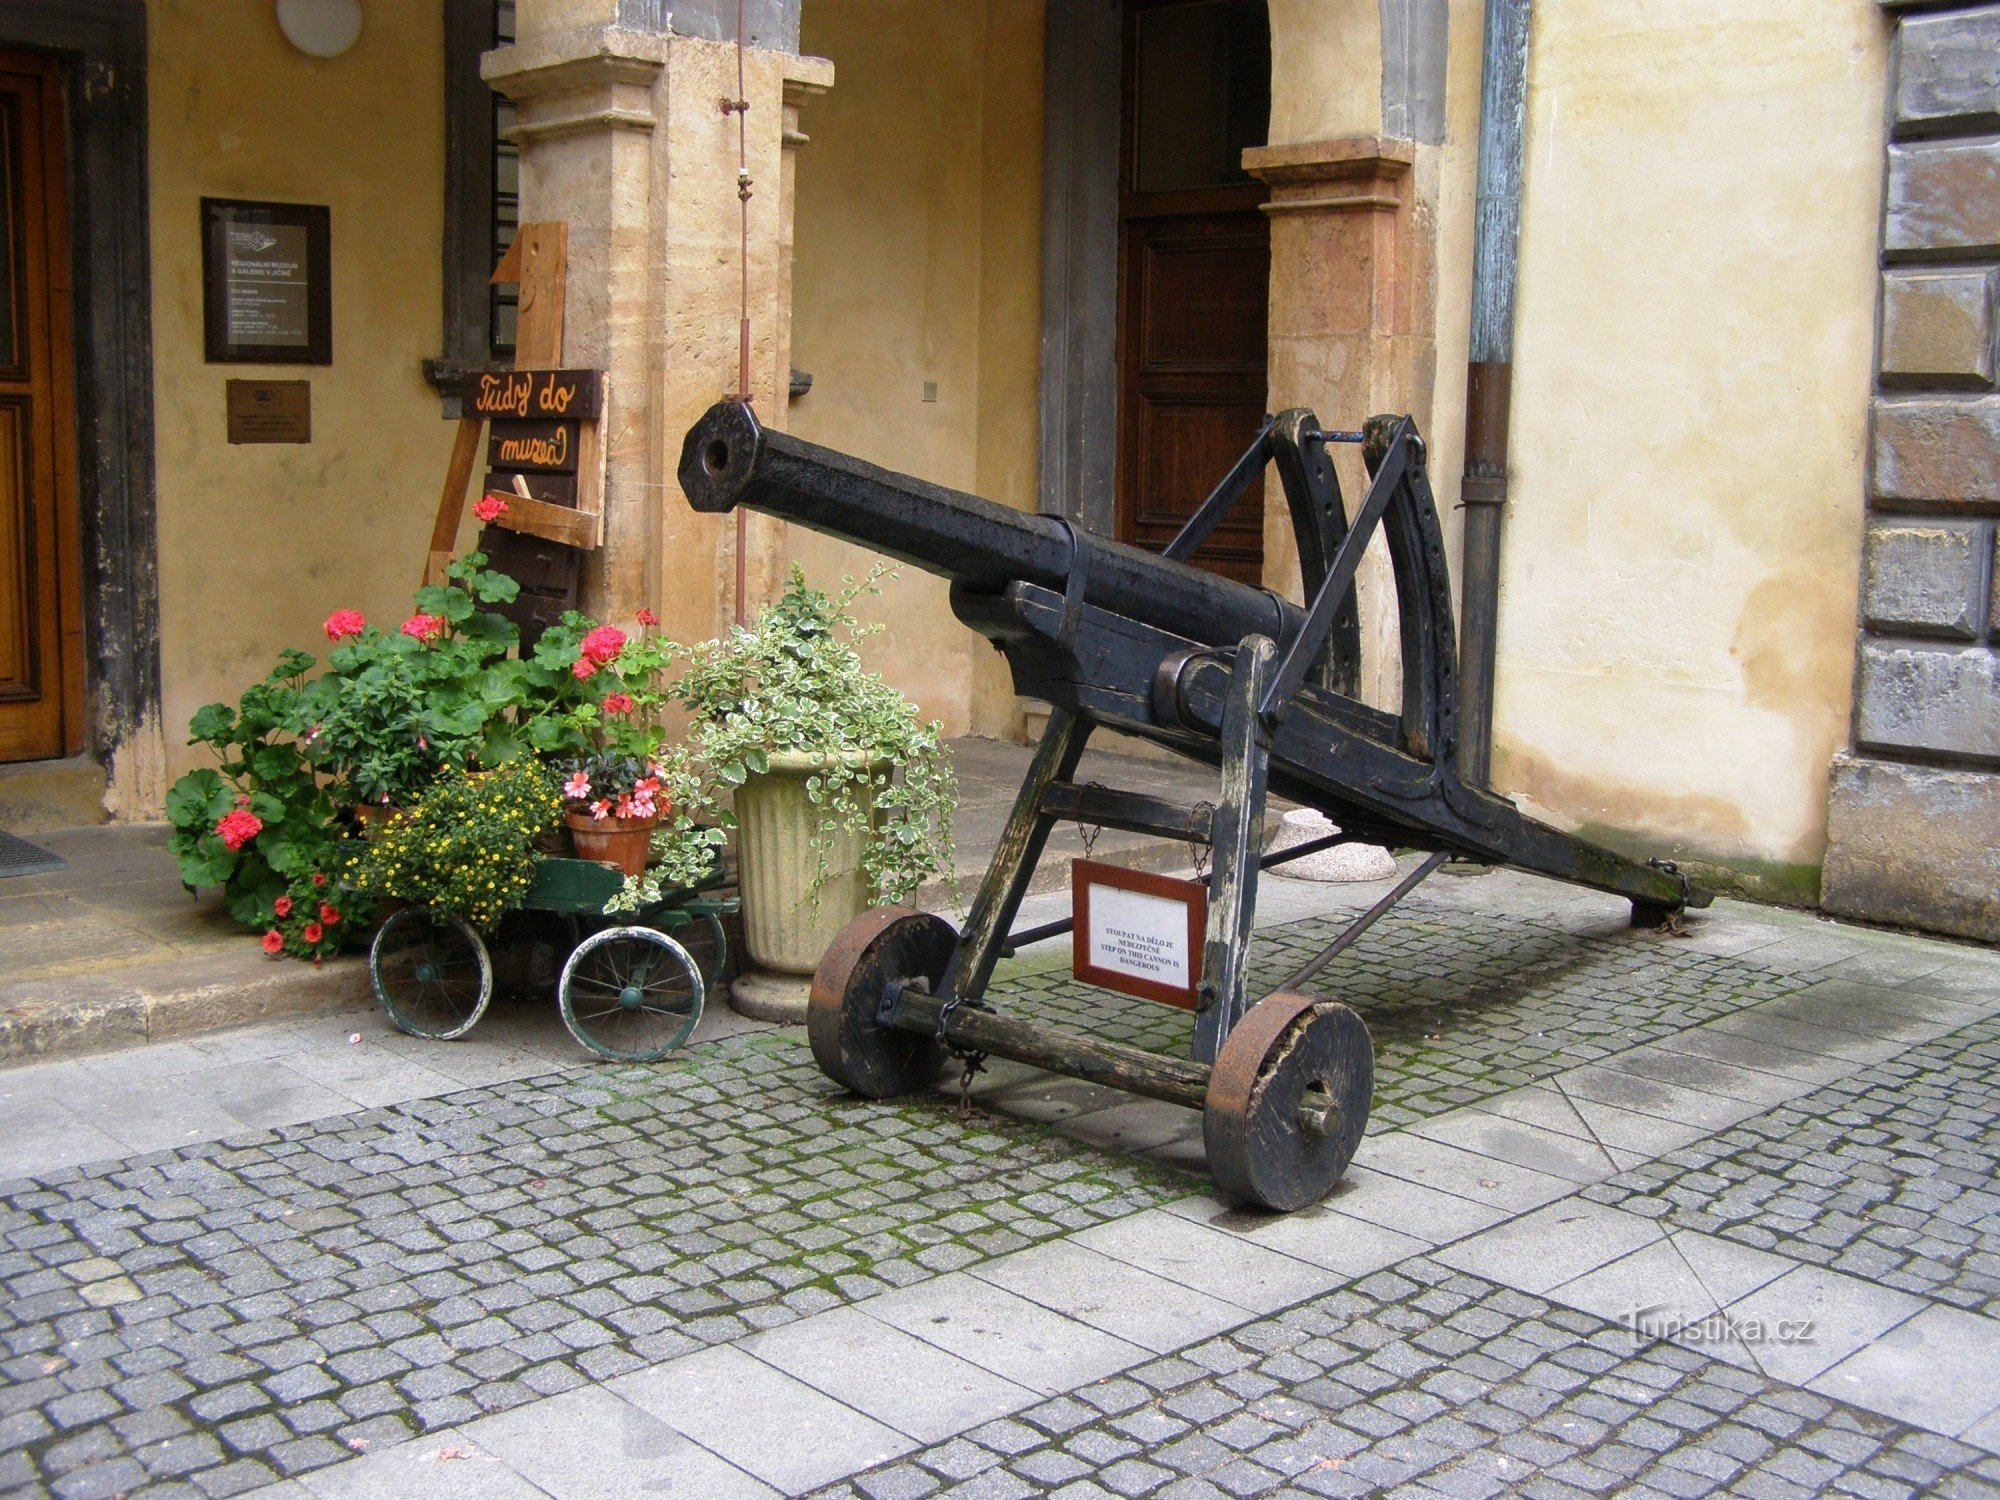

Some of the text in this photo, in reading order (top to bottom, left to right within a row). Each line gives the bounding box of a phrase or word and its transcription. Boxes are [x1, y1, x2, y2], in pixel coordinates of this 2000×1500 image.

[271, 261, 298, 269] MUZEUM
[476, 373, 576, 417] Tudy do
[501, 426, 567, 466] muzea
[1105, 927, 1174, 948] STOUPAT NA DĚLO JE
[1118, 939, 1161, 954] NEBEZPEČNÉ
[1100, 943, 1116, 952] STEP
[1128, 950, 1143, 959] THIS
[1144, 953, 1172, 965] CANNON
[1173, 960, 1180, 968] IS
[1119, 956, 1160, 972] DANGEROUS
